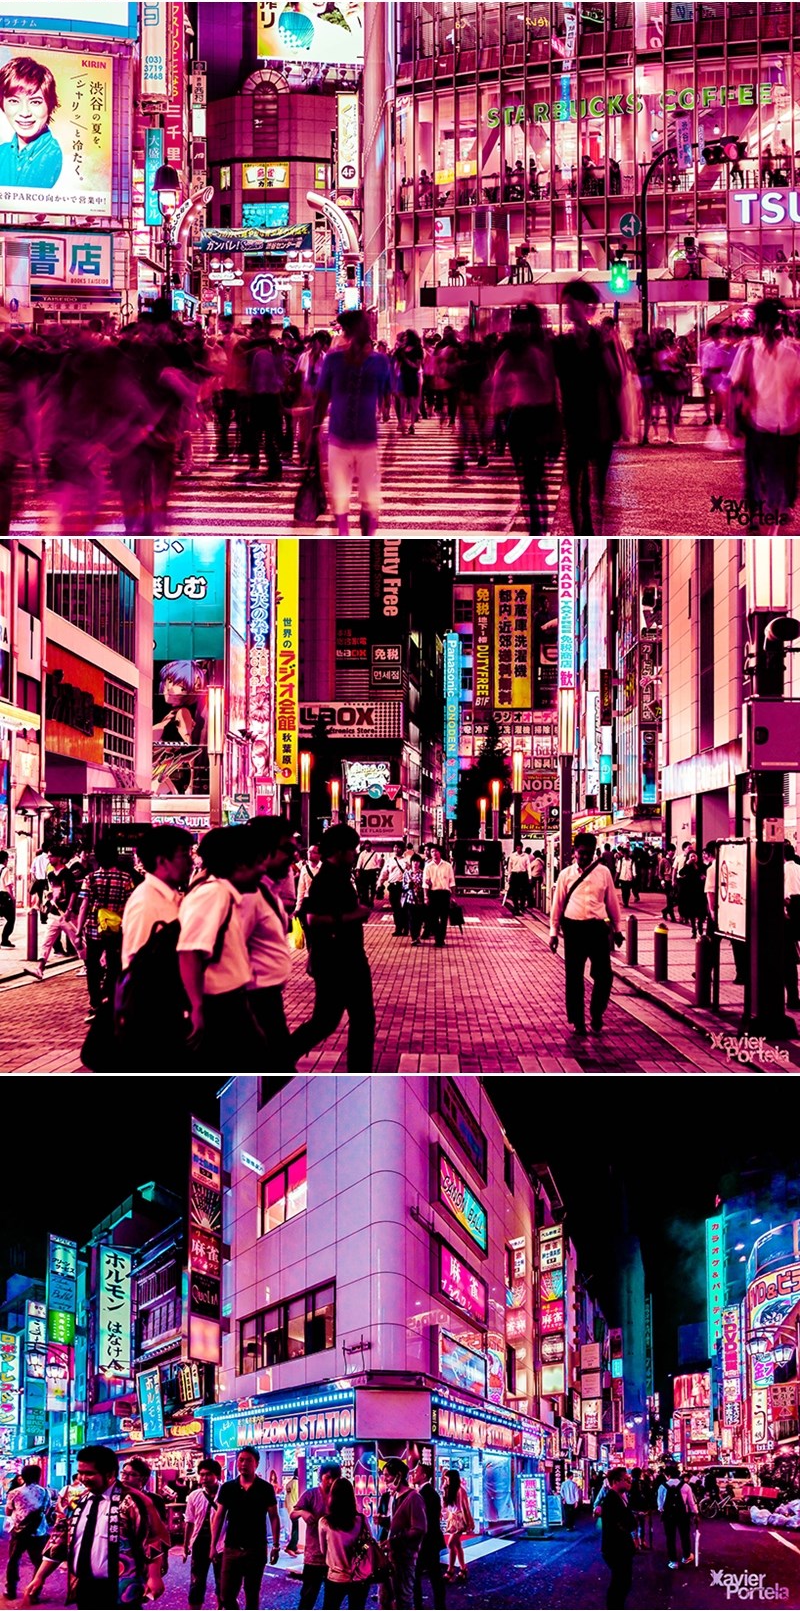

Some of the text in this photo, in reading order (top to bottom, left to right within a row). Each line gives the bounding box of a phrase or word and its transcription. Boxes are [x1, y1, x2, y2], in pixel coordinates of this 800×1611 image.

[81, 60, 107, 69] KIRIN
[487, 83, 772, 128] STARBUCKS COFFEE
[383, 579, 401, 616] Free
[477, 589, 489, 615] 免税
[514, 590, 527, 677] 冷蔵庫洗濯機
[374, 648, 399, 660] 免税
[448, 640, 457, 697] Panasonic
[278, 650, 295, 730] ラジオ会館
[476, 697, 489, 706] B1F
[282, 734, 291, 764] 秋葉原
[105, 1252, 128, 1311] ホルモン
